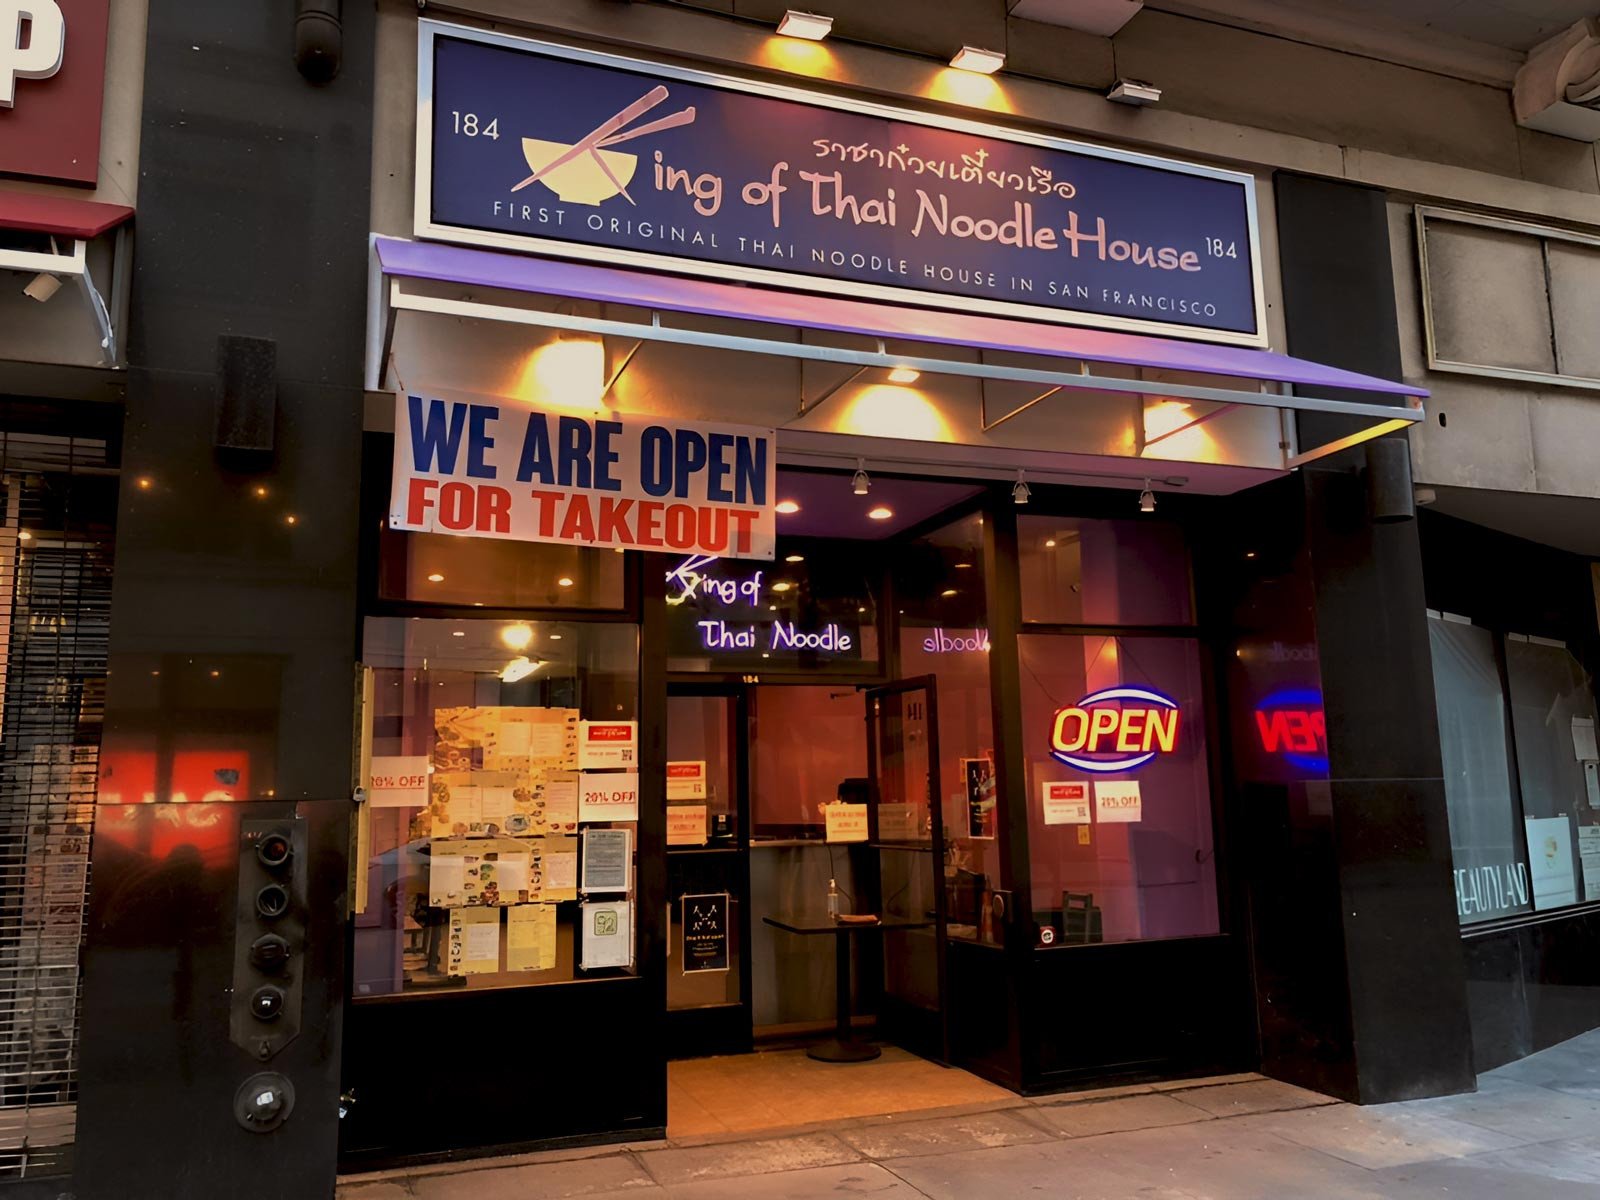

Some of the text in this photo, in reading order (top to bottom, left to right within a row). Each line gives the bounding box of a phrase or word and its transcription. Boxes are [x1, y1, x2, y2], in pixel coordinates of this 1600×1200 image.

[452, 111, 500, 141] 184
[741, 160, 789, 229] of
[798, 169, 897, 227] Thai
[910, 188, 1058, 250] Noodle
[1062, 209, 1202, 273] House
[493, 200, 1217, 318] FIRST ORIGINAL THAI NOODLE HOUSE IN SAN FRANCISCO
[1205, 236, 1238, 259] 184
[407, 395, 767, 506] WE ARE OPEN
[406, 476, 760, 554] FOR TAKEOUT
[740, 570, 764, 607] of
[697, 619, 852, 652] Thai Noodle
[1050, 705, 1180, 754] OPEN
[398, 775, 425, 787] OFF
[612, 791, 636, 803] OFF
